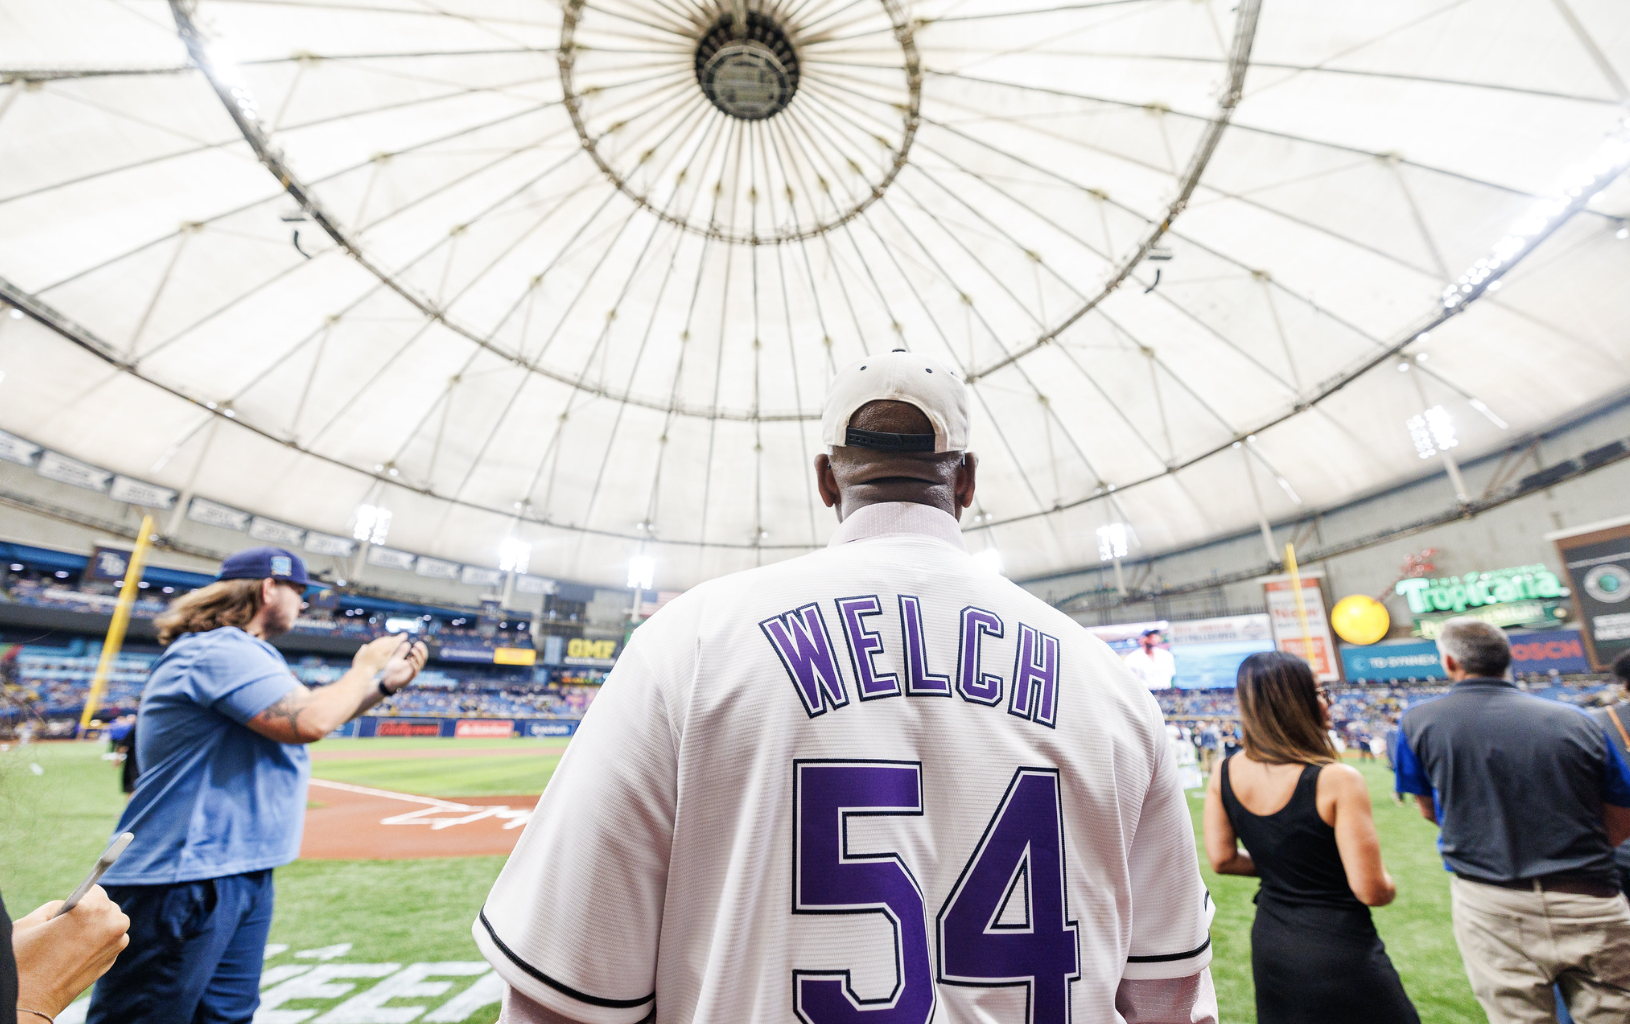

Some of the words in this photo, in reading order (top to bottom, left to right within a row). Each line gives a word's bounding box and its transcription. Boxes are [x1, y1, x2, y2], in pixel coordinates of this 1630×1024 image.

[1395, 570, 1562, 613] Tropicana
[758, 594, 1060, 729] WELCH
[1510, 639, 1584, 662] OSCH
[792, 758, 1081, 1024] 54
